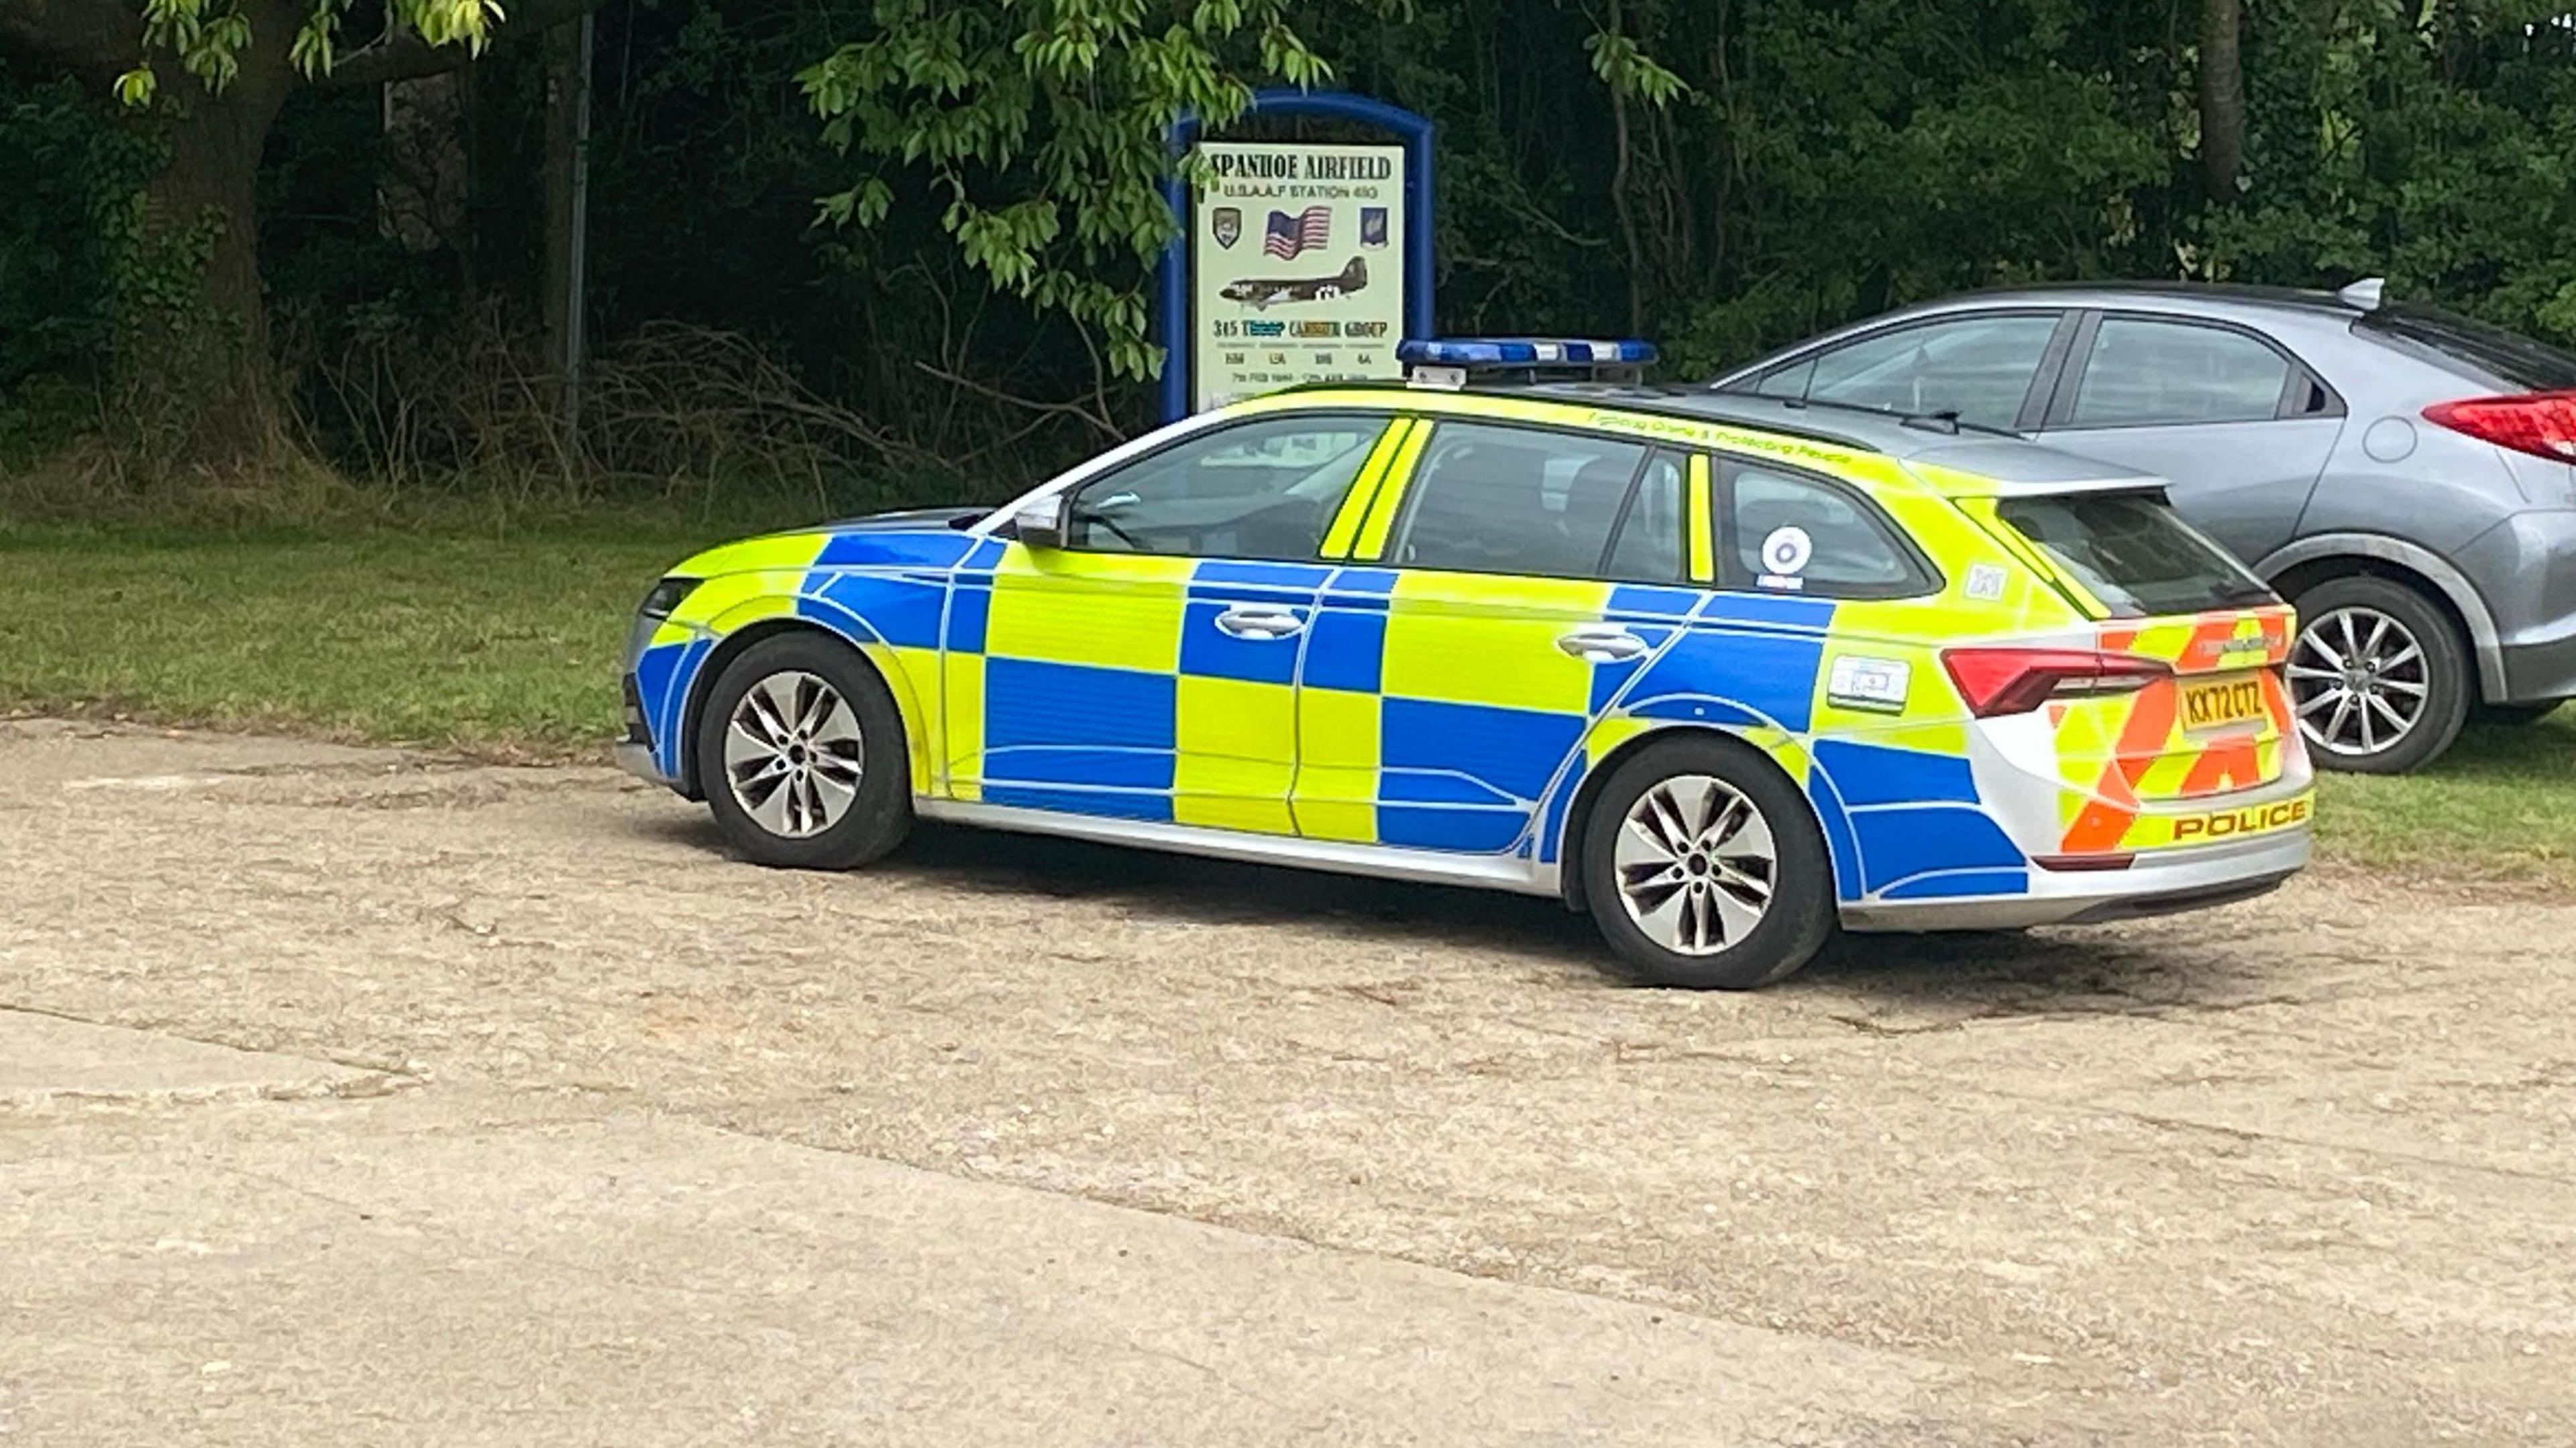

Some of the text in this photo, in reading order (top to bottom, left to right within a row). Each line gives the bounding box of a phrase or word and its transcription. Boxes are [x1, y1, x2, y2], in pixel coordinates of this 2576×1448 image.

[1211, 154, 1392, 180] SPANHOE AIRFIELD
[1289, 184, 1350, 199] STATION
[1213, 319, 1238, 337] 315
[2171, 800, 2306, 841] POLICE
